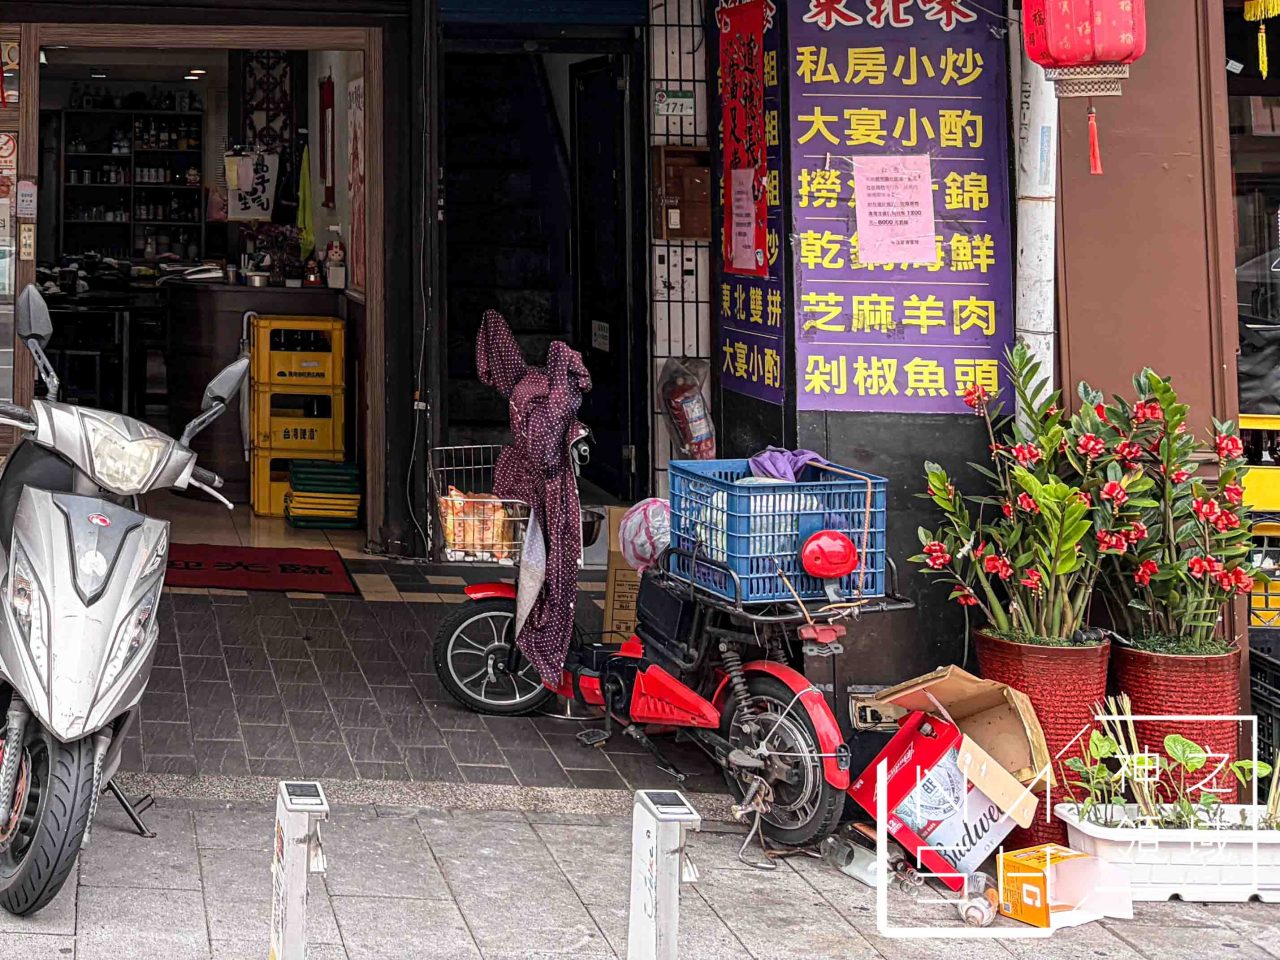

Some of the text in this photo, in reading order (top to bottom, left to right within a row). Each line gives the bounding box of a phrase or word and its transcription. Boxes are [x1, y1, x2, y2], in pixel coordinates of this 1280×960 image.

[796, 46, 985, 87] 私房小炒
[665, 102, 684, 113] 171
[797, 107, 984, 149] 大宴小酌
[797, 168, 990, 211] 撈錦
[720, 282, 782, 328] 東北雙拼
[801, 292, 997, 336] 芝麻羊肉
[722, 338, 781, 389] 大宴小酌
[804, 355, 999, 398] 剁椒魚頭
[937, 798, 1005, 869] Budwe
